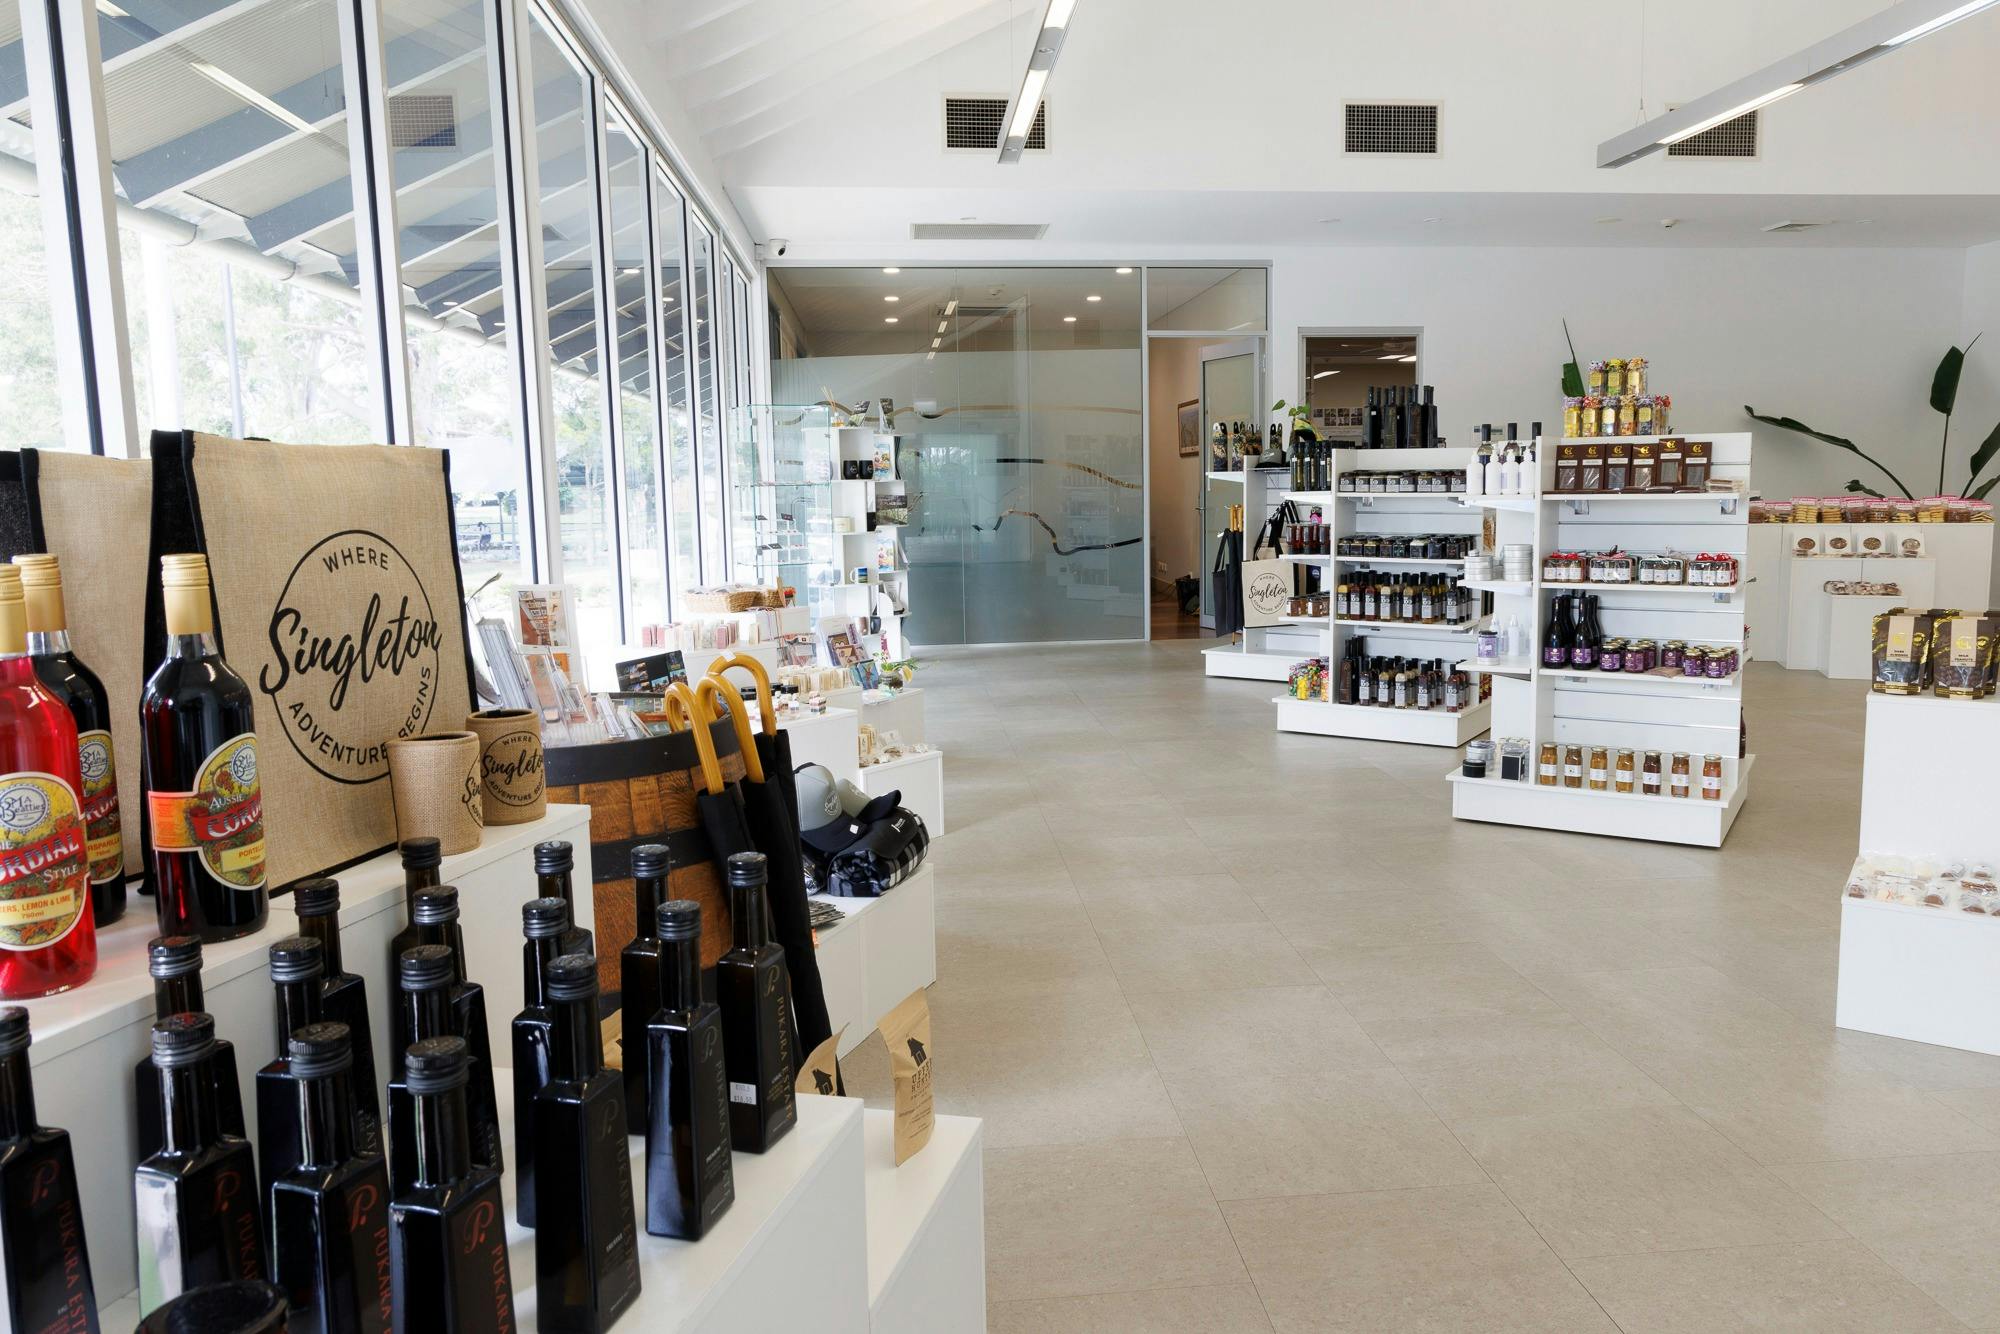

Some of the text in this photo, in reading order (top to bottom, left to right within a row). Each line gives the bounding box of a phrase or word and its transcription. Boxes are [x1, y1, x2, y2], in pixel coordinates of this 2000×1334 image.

[323, 547, 389, 573] WHERE
[1248, 583, 1288, 603] Singleton
[259, 593, 443, 712] Singleton
[289, 702, 388, 766] ADVENTURE
[500, 735, 532, 746] WHERE
[488, 781, 532, 801] ADVENTURE
[209, 795, 244, 810] AUSSIE
[43, 864, 78, 884] STYLE
[22, 899, 50, 912] LEMON
[56, 894, 71, 907] LIME
[776, 995, 790, 1062] PUKARA
[56, 1198, 81, 1290] PUKARA
